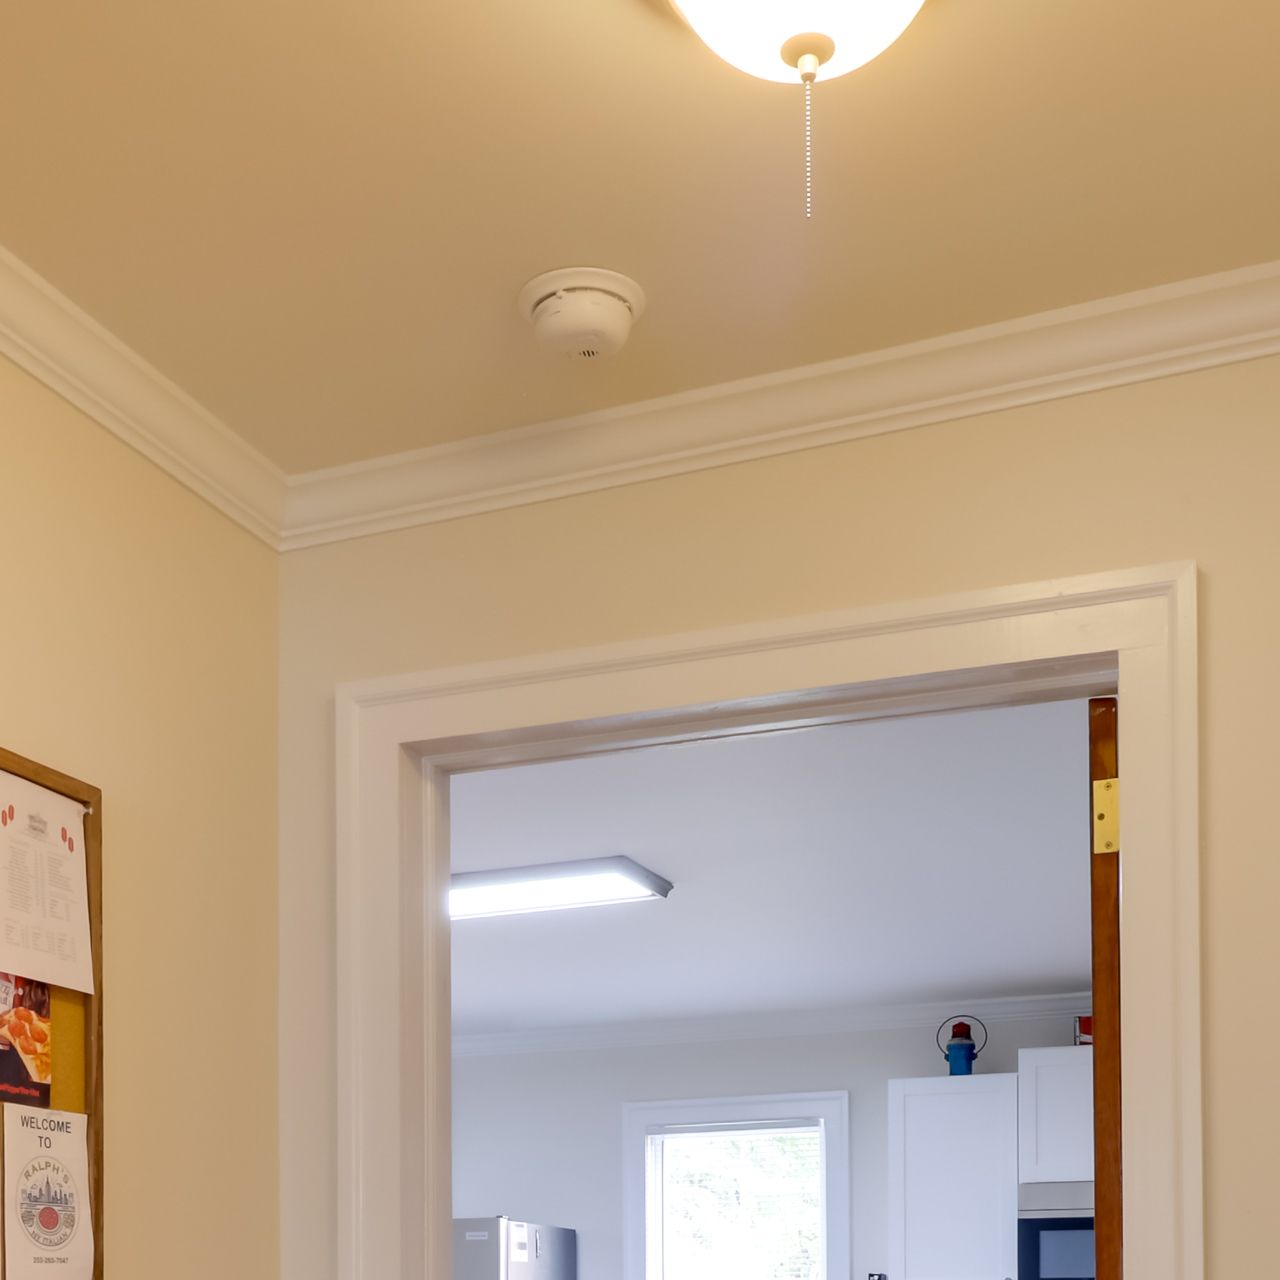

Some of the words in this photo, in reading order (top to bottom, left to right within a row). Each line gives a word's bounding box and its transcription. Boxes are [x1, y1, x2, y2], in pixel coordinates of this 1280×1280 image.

[20, 1115, 72, 1134] WELCOME
[38, 1135, 52, 1149] TO
[24, 1160, 70, 1184] RALPH'S
